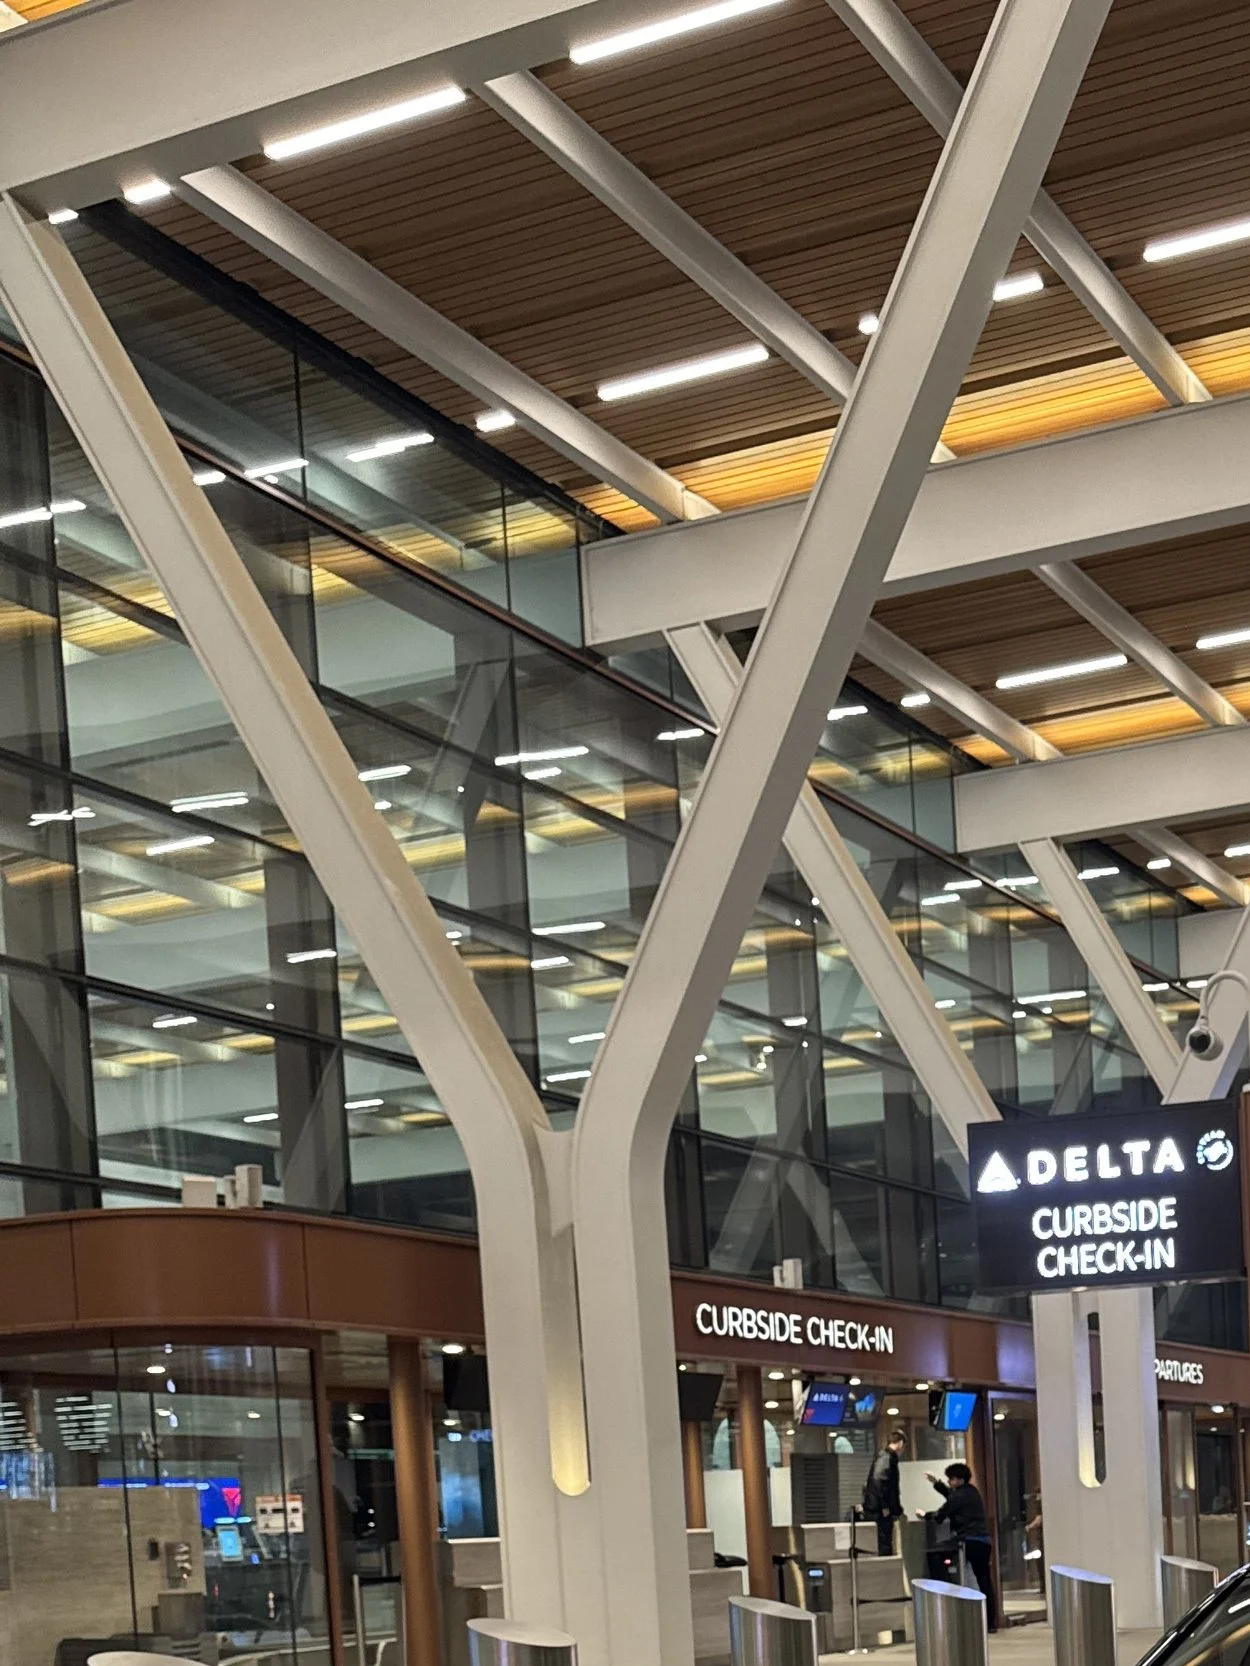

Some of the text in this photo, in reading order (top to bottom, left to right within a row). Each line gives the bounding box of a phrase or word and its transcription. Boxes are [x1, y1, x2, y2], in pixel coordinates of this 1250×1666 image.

[1027, 1137, 1185, 1185] DELTA
[1032, 1197, 1178, 1240] CURBSIDE
[1037, 1238, 1176, 1278] CHECK-IN
[696, 1303, 894, 1353] CURBSIDE CHECK-IN
